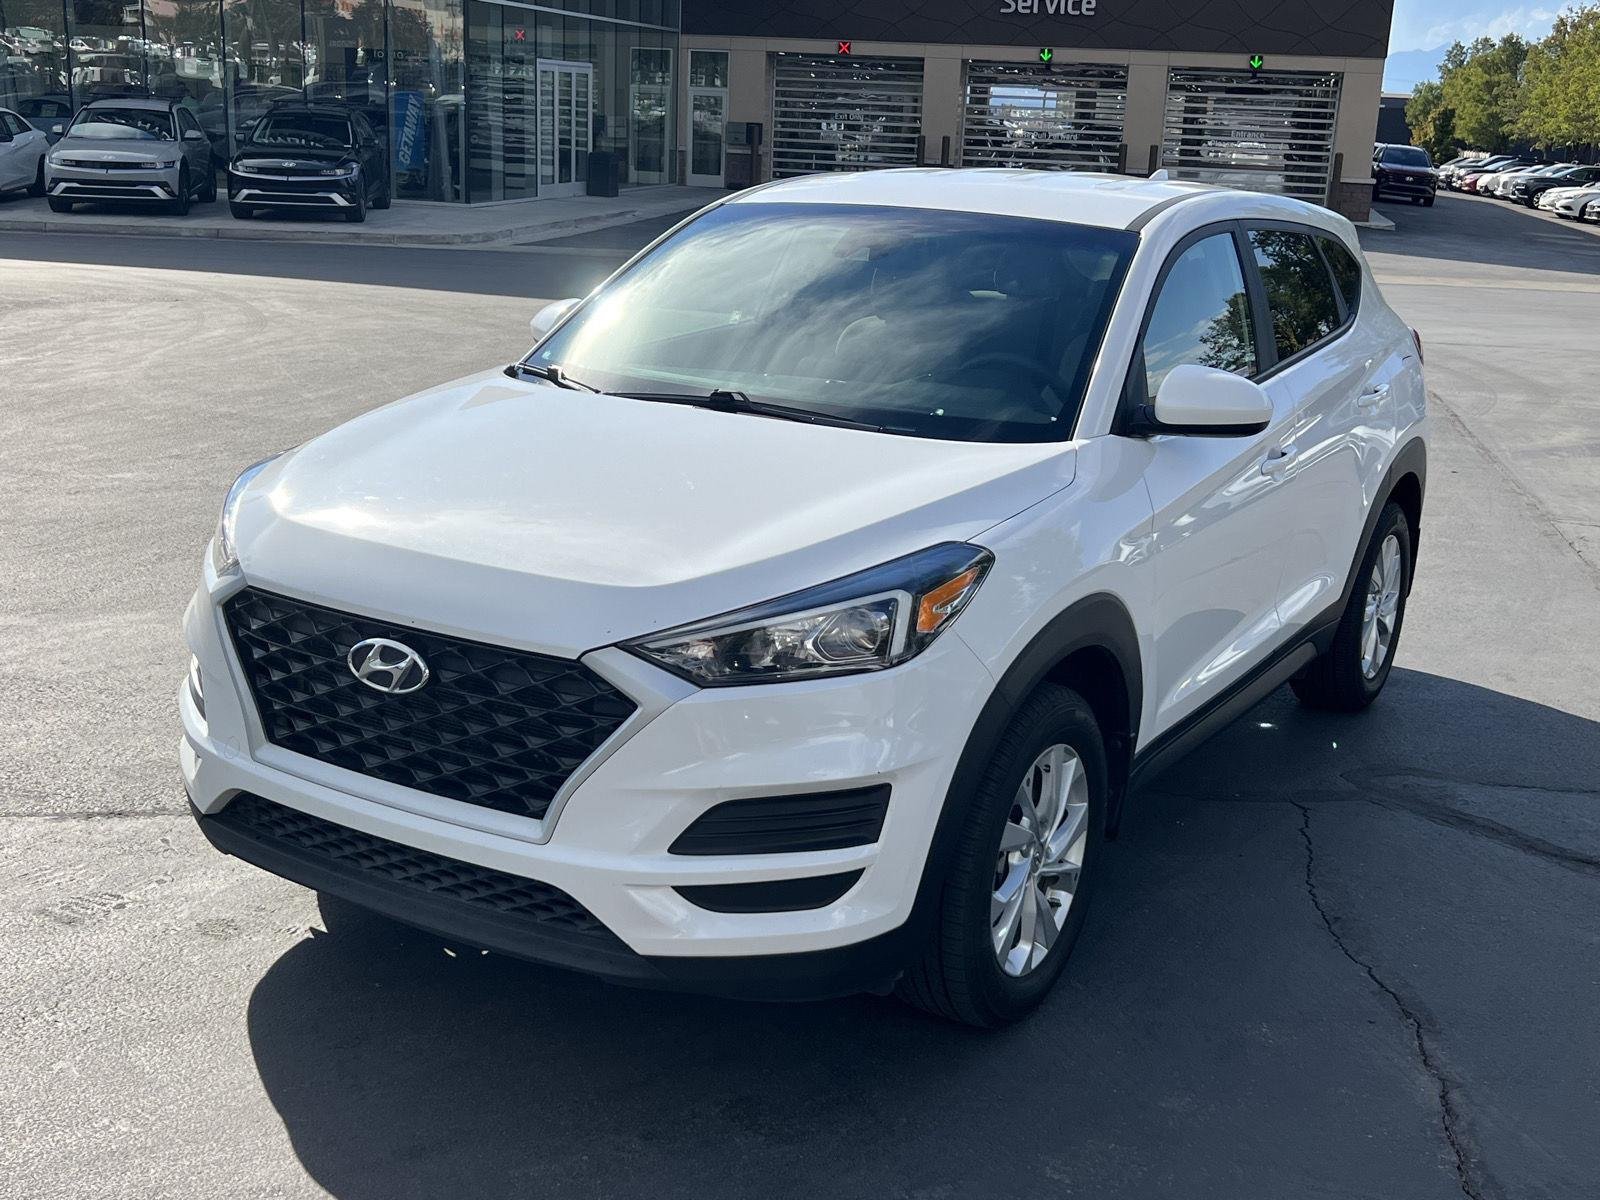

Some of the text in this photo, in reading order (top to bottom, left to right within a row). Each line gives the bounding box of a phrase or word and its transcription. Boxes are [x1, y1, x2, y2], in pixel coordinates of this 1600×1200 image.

[1000, 0, 1097, 15] Service
[398, 93, 421, 165] GETAWAY
[1231, 130, 1265, 139] Entrance
